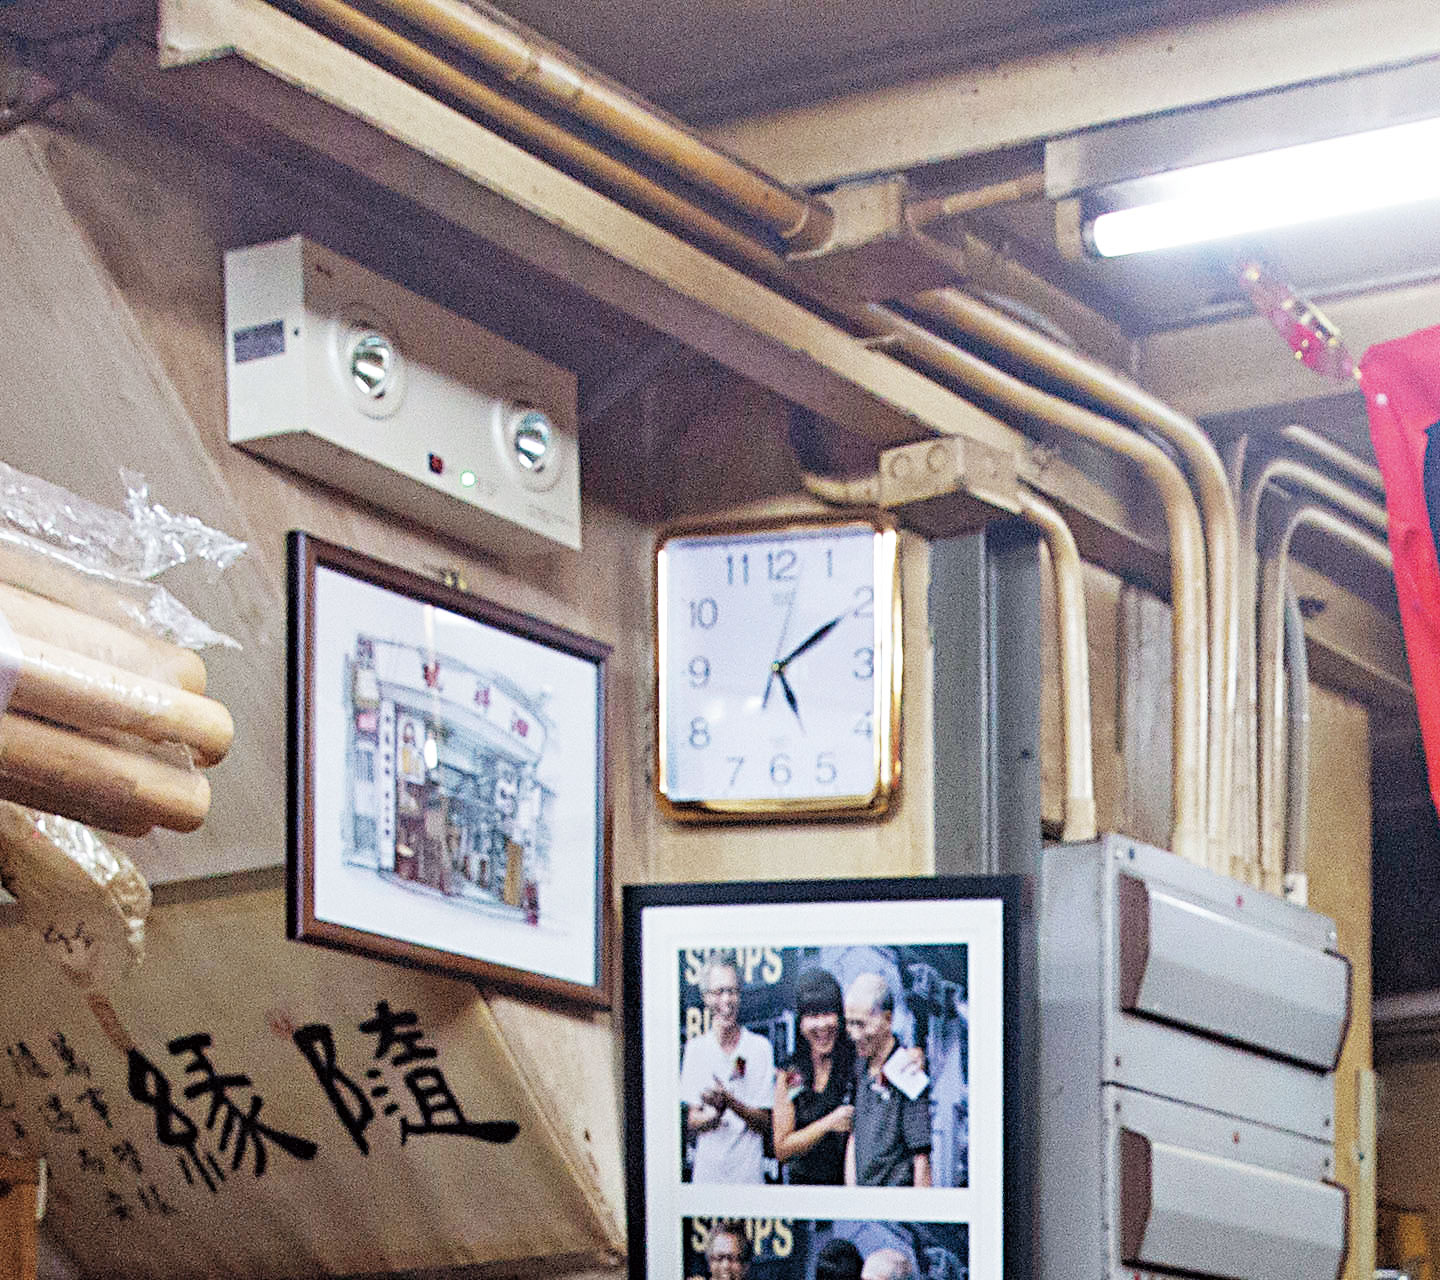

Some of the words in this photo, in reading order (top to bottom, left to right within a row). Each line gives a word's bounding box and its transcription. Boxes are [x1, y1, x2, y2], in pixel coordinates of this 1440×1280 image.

[726, 553, 750, 585] 11
[766, 549, 797, 581] 12
[825, 548, 834, 578] 1
[688, 597, 718, 630] 10
[853, 585, 875, 619] 2
[688, 655, 710, 689] 9
[854, 647, 875, 680] 3
[688, 716, 711, 749] 8
[854, 711, 874, 739] 4
[726, 756, 745, 787] 7
[770, 753, 792, 787] 6
[816, 752, 837, 784] 5
